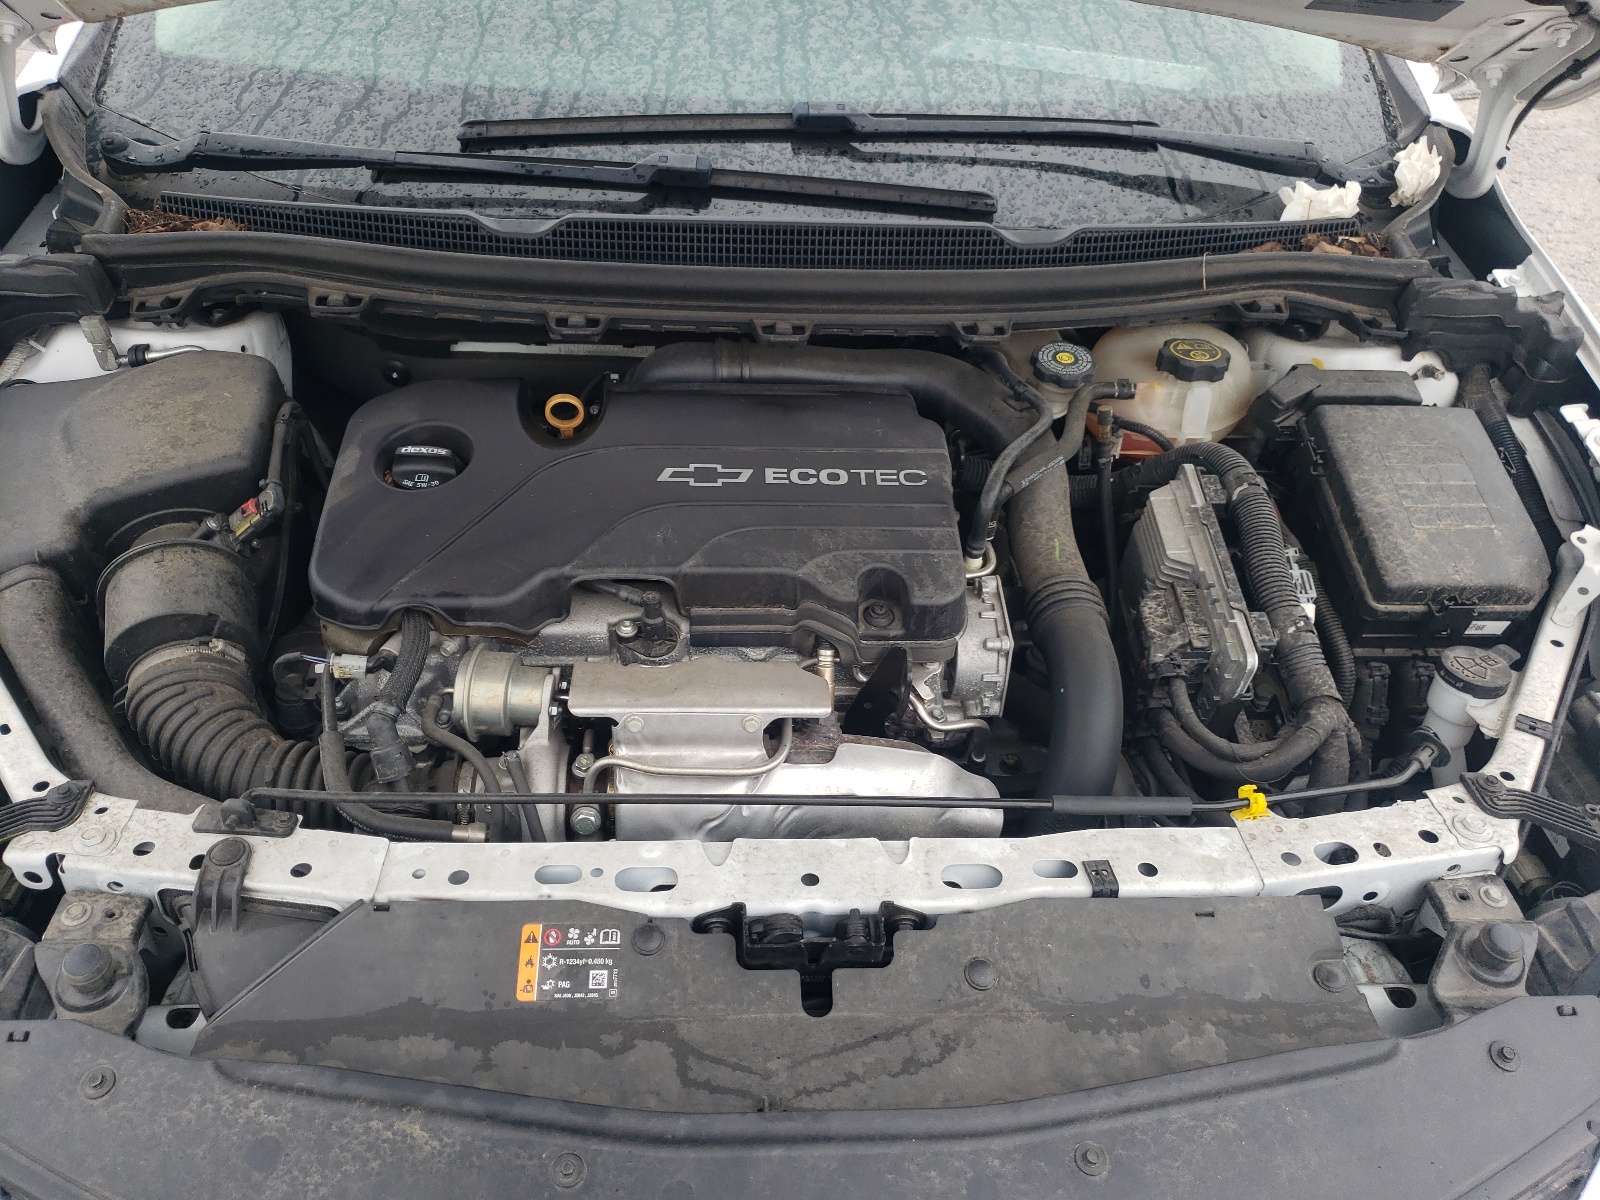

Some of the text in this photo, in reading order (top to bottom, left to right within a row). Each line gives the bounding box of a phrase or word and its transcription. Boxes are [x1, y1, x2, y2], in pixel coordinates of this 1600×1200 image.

[401, 445, 447, 455] dexos
[764, 467, 928, 486] ECOTEC
[605, 958, 613, 966] kg
